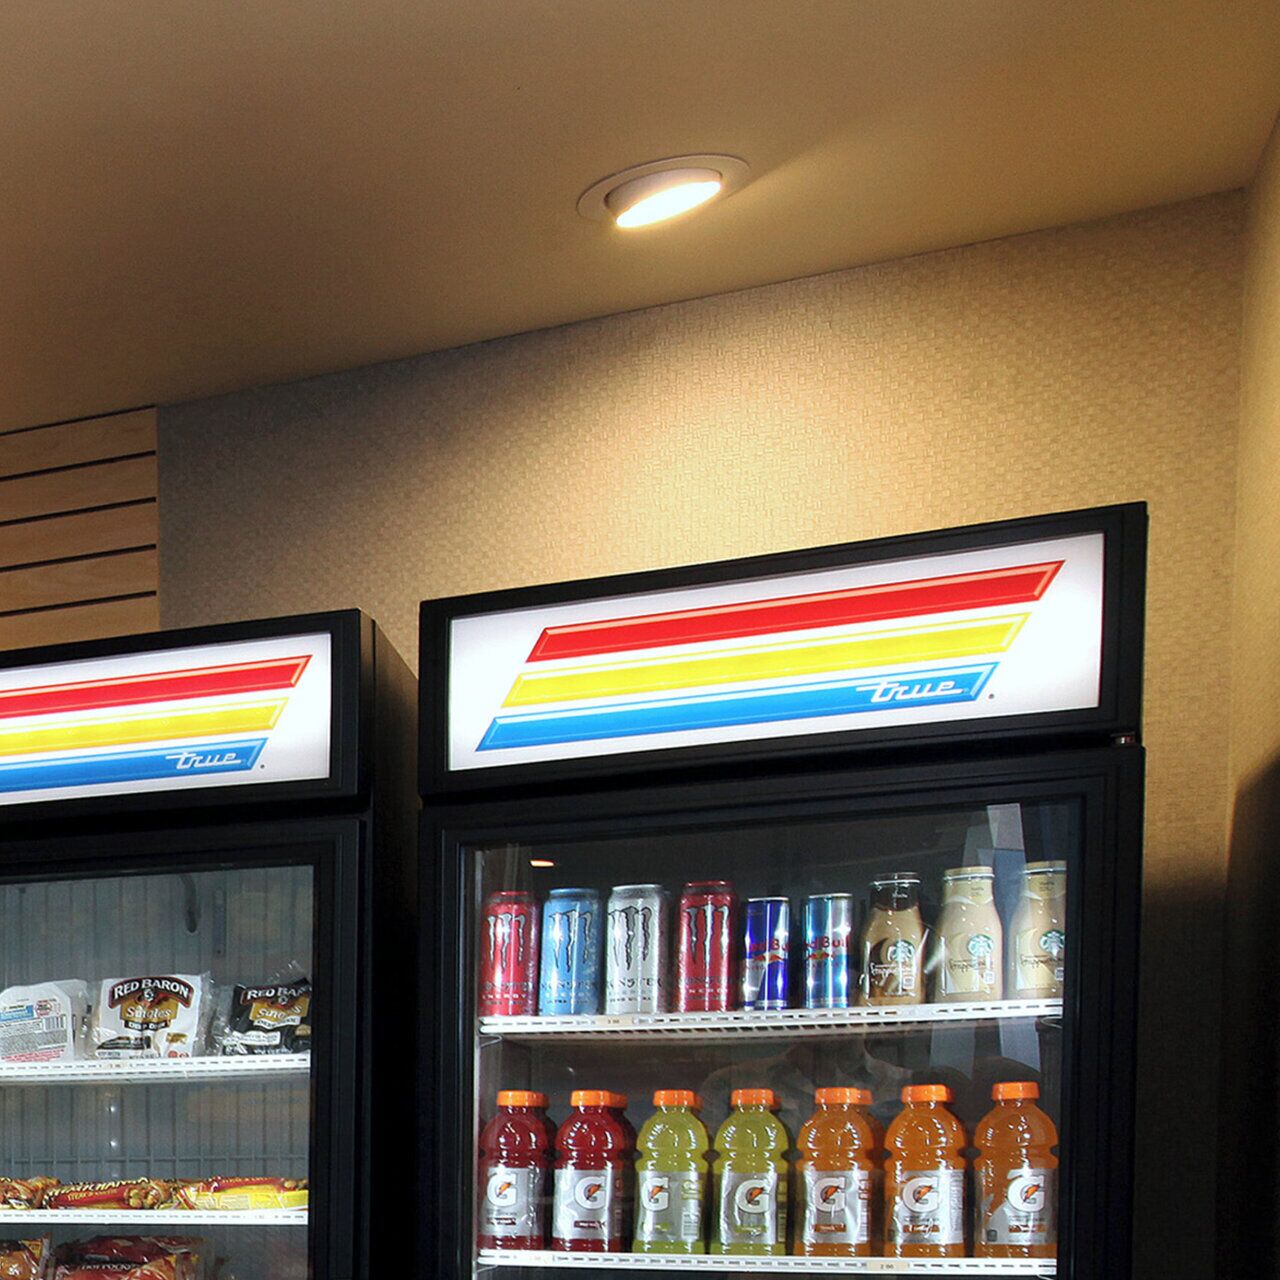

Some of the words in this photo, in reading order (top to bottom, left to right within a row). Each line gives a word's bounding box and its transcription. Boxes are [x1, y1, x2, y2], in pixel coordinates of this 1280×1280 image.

[114, 979, 140, 999] RED
[142, 976, 189, 996] BARON
[487, 1173, 517, 1207] G
[575, 1176, 607, 1209] G
[642, 1177, 669, 1211] G
[735, 1179, 770, 1213] G
[813, 1177, 846, 1212] G
[902, 1176, 939, 1212] G
[1007, 1175, 1045, 1212] G
